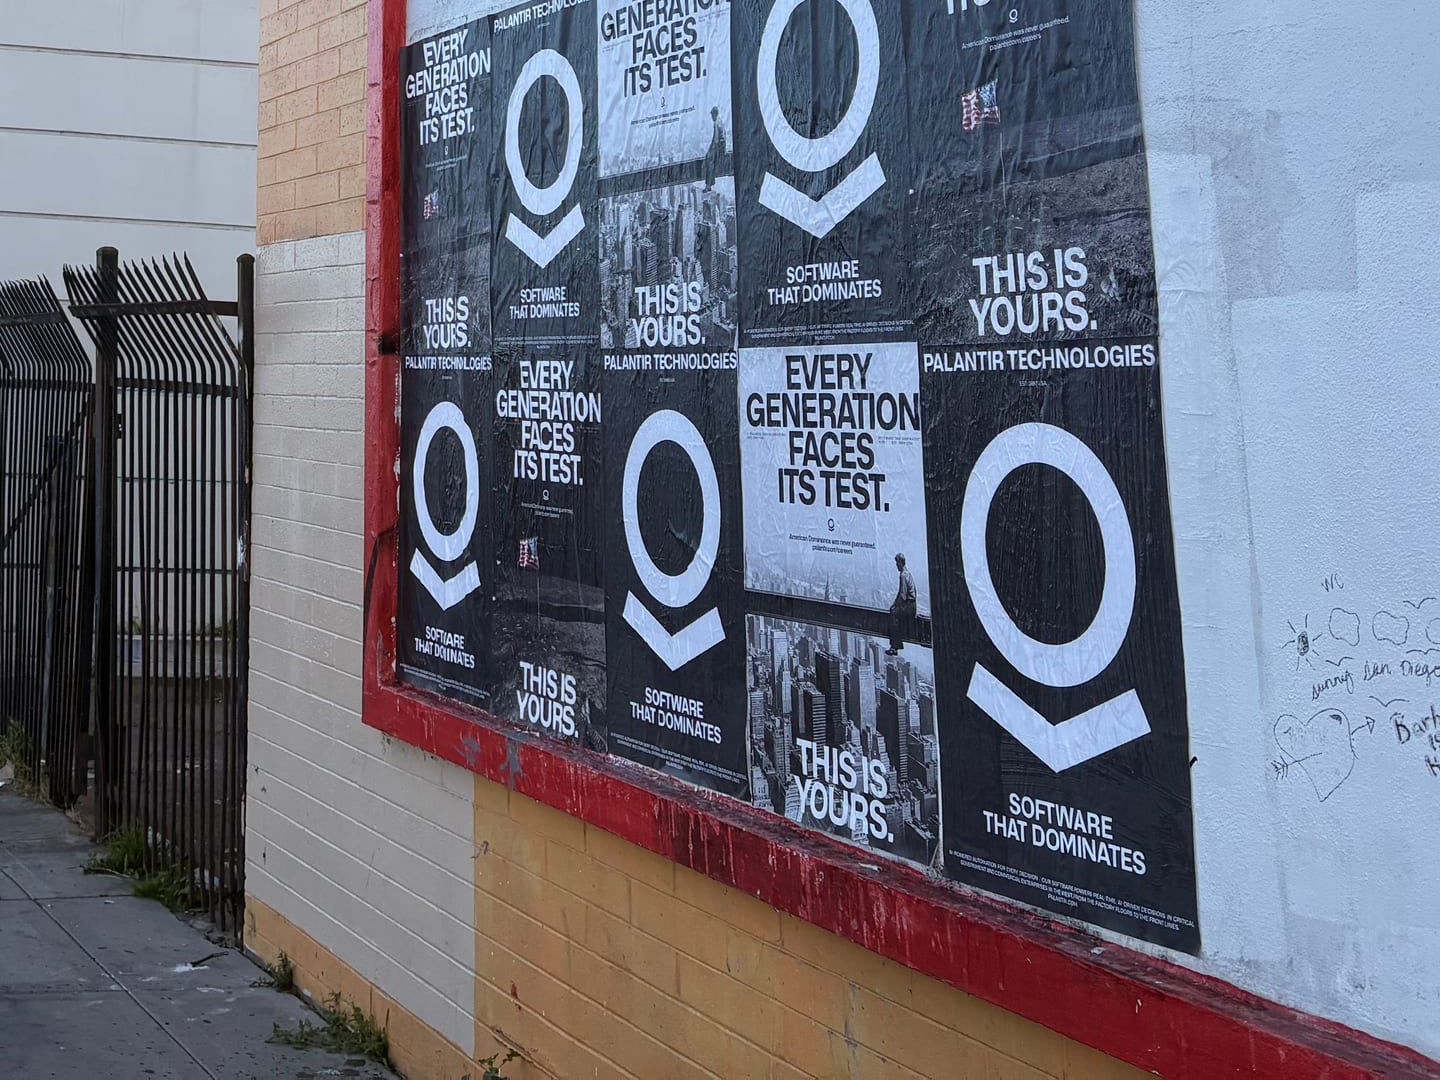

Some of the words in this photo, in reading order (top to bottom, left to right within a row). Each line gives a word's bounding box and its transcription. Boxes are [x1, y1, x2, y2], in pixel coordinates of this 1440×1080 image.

[494, 7, 531, 33] PALANTIR
[423, 28, 469, 67] EVERY
[632, 17, 698, 64] FACES
[405, 47, 491, 98] GENERATION
[624, 62, 652, 97] ITS
[656, 46, 707, 89] TEST.
[426, 82, 468, 118] FACES
[420, 117, 439, 145] ITS
[440, 107, 475, 140] TEST.
[786, 260, 860, 284] SOFTWARE
[972, 251, 1048, 295] THIS
[1054, 247, 1088, 288] IS
[425, 297, 454, 323] THIS
[520, 286, 567, 303] SOFTWARE
[634, 283, 679, 315] THIS
[682, 281, 701, 313] IS
[768, 286, 800, 305] THAT
[802, 278, 882, 302] DOMINATES
[509, 304, 528, 320] THAT
[530, 302, 580, 318] DOMINATES
[969, 290, 1098, 336] YOURS.
[423, 322, 471, 349] YOURS.
[632, 314, 706, 347] YOURS.
[519, 360, 574, 390] EVERY
[604, 354, 652, 370] PALANTIR
[654, 352, 737, 370] TECHNOLOGIES
[785, 353, 873, 390] EVERY
[923, 351, 1004, 372] PALANTIR
[1007, 344, 1156, 370] TECHNOLOGIES
[496, 390, 602, 423] GENERATION
[746, 392, 921, 431] GENERATION
[521, 420, 575, 453] FACES
[789, 430, 875, 470] FACES
[513, 449, 538, 480] ITS
[540, 452, 583, 486] TEST.
[778, 468, 816, 505] ITS
[819, 470, 890, 512] TEST.
[414, 637, 434, 655] THAT
[519, 660, 558, 700] THIS
[561, 672, 577, 705] IS
[516, 690, 579, 738] YOURS.
[644, 686, 704, 719] SOFTWARE
[629, 701, 656, 724] THAT
[658, 709, 722, 744] DOMINATES
[796, 738, 857, 789] THIS
[862, 756, 888, 798] IS
[794, 775, 894, 843] YOURS.
[1009, 792, 1113, 840] SOFTWARE
[982, 810, 1027, 842] THAT
[1031, 823, 1147, 875] DOMINATES
